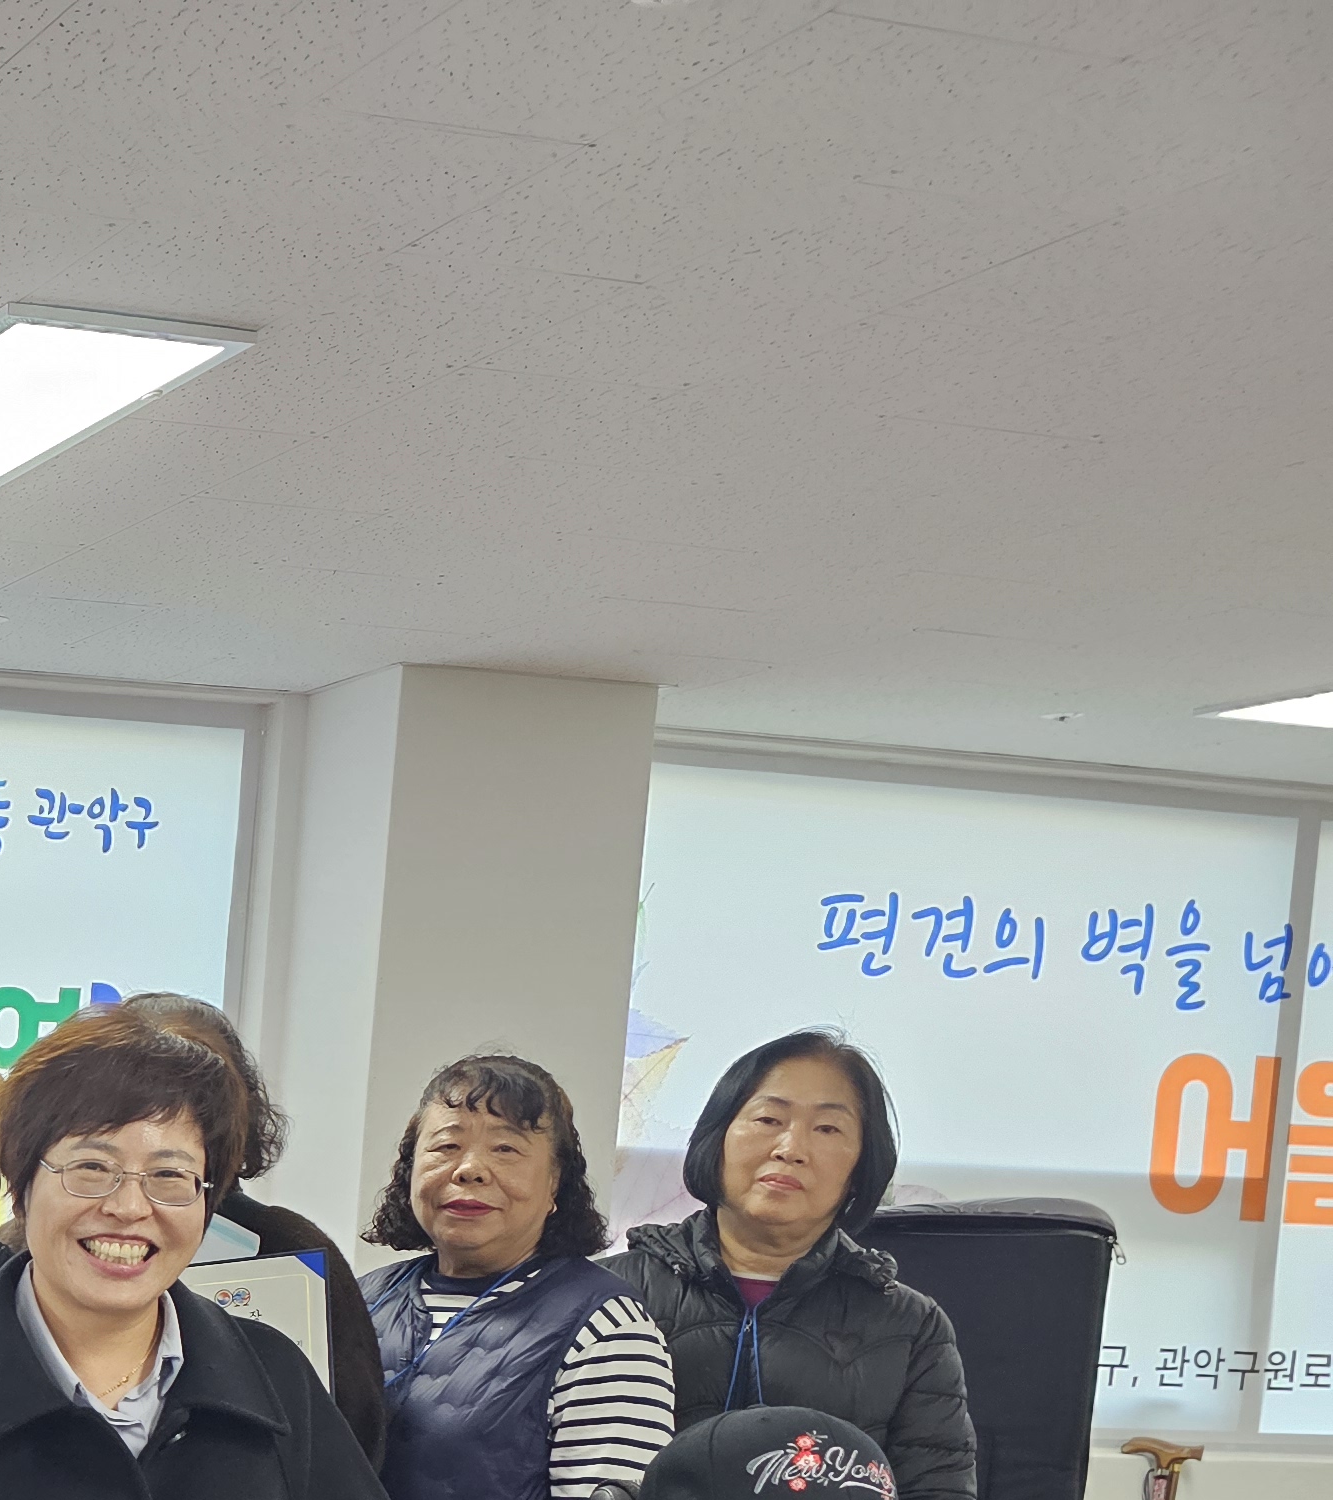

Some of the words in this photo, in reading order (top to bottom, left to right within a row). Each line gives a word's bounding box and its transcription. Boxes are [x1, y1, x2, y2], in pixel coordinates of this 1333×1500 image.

[28, 786, 158, 853] 관악구
[816, 892, 1047, 980] 편견의
[1081, 898, 1211, 1010] 벽을
[746, 1449, 827, 1495] New
[824, 1446, 896, 1497] York
